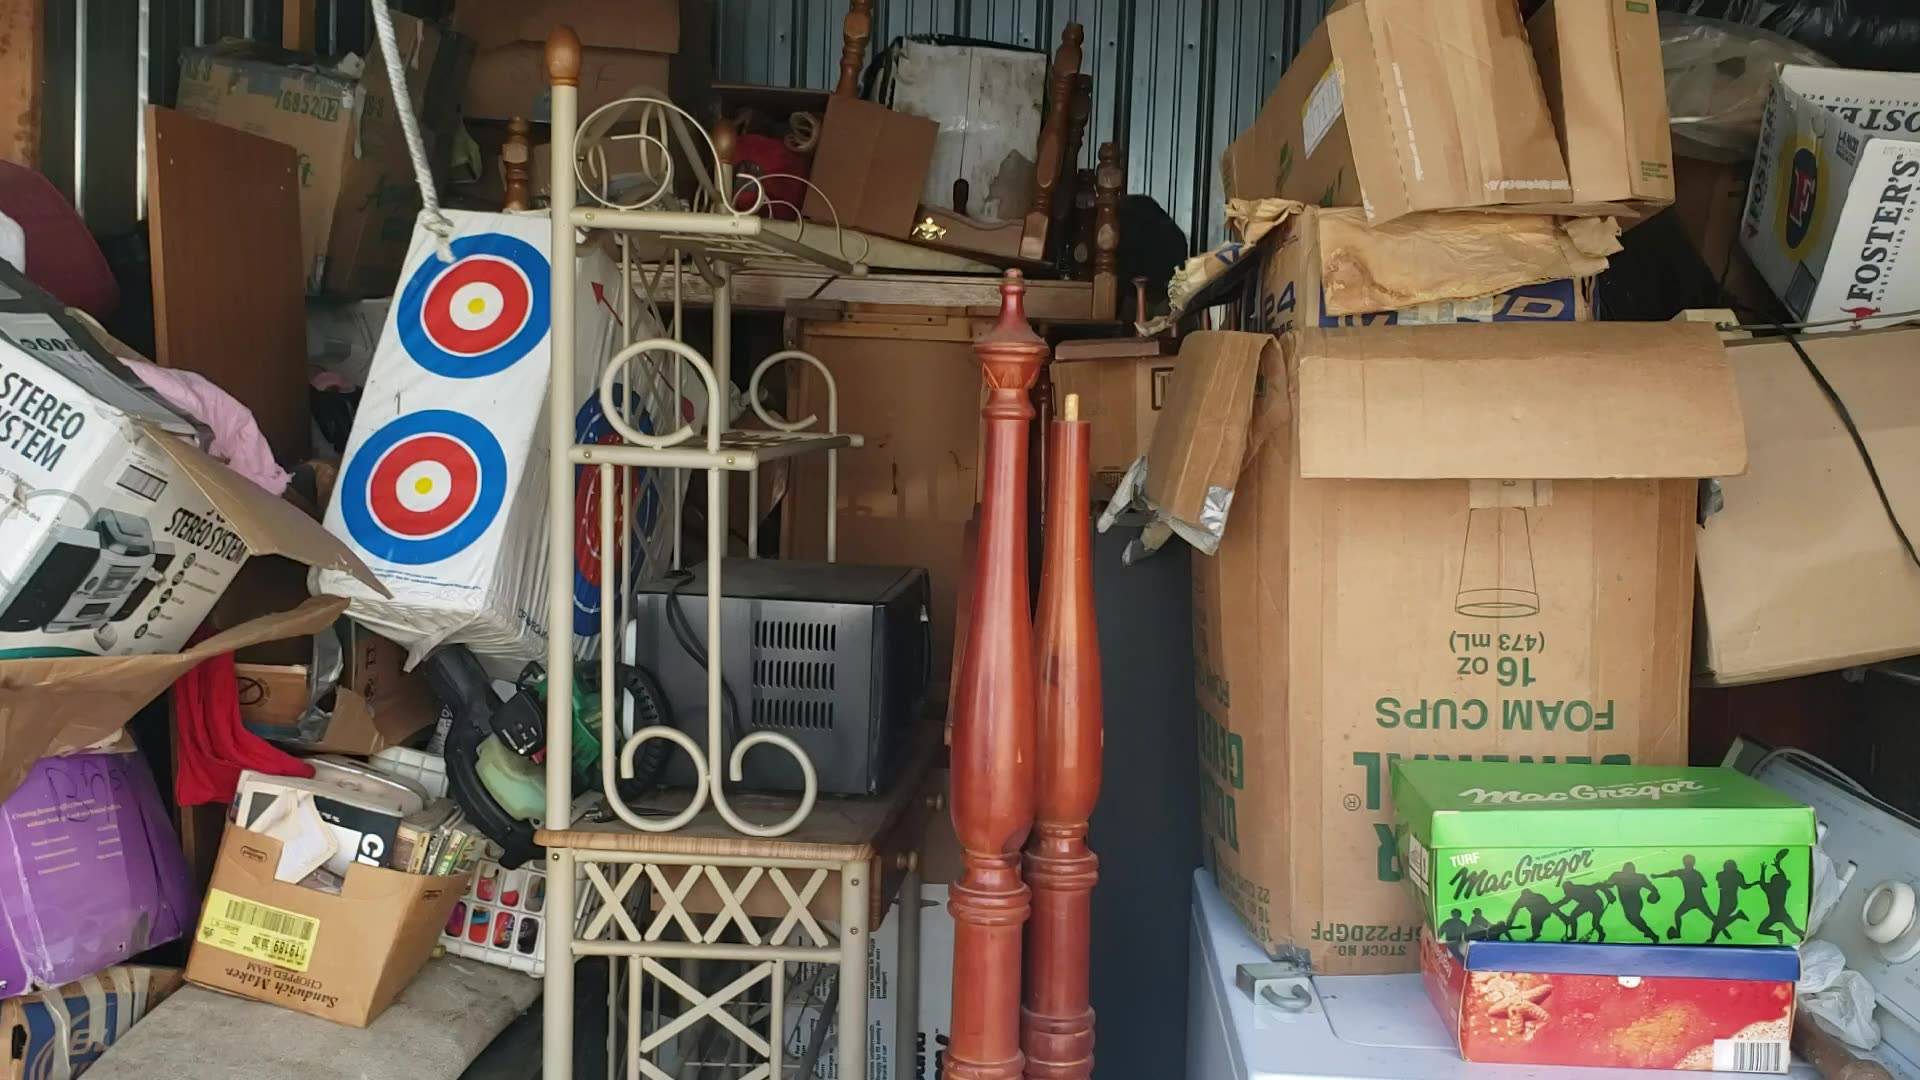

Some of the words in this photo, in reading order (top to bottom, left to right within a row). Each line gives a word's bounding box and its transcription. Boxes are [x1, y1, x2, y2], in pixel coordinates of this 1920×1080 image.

[1846, 159, 1920, 303] FOSTER'S
[0, 371, 86, 441] STEREO
[164, 506, 213, 547] STEREO
[204, 522, 249, 565] SYSTEM
[1449, 630, 1491, 654] mL)
[1497, 631, 1545, 654] (473
[1496, 656, 1537, 687] 16
[1374, 697, 1489, 730] CUPS
[1502, 699, 1615, 732] FOAM
[1449, 852, 1481, 867] TURF
[1449, 849, 1595, 900] MacGregor
[1361, 945, 1407, 957] STOCK
[225, 967, 271, 991] Maker
[246, 961, 272, 976] HAM
[273, 970, 323, 990] CHOPPED
[274, 980, 339, 1009] Sandwich
